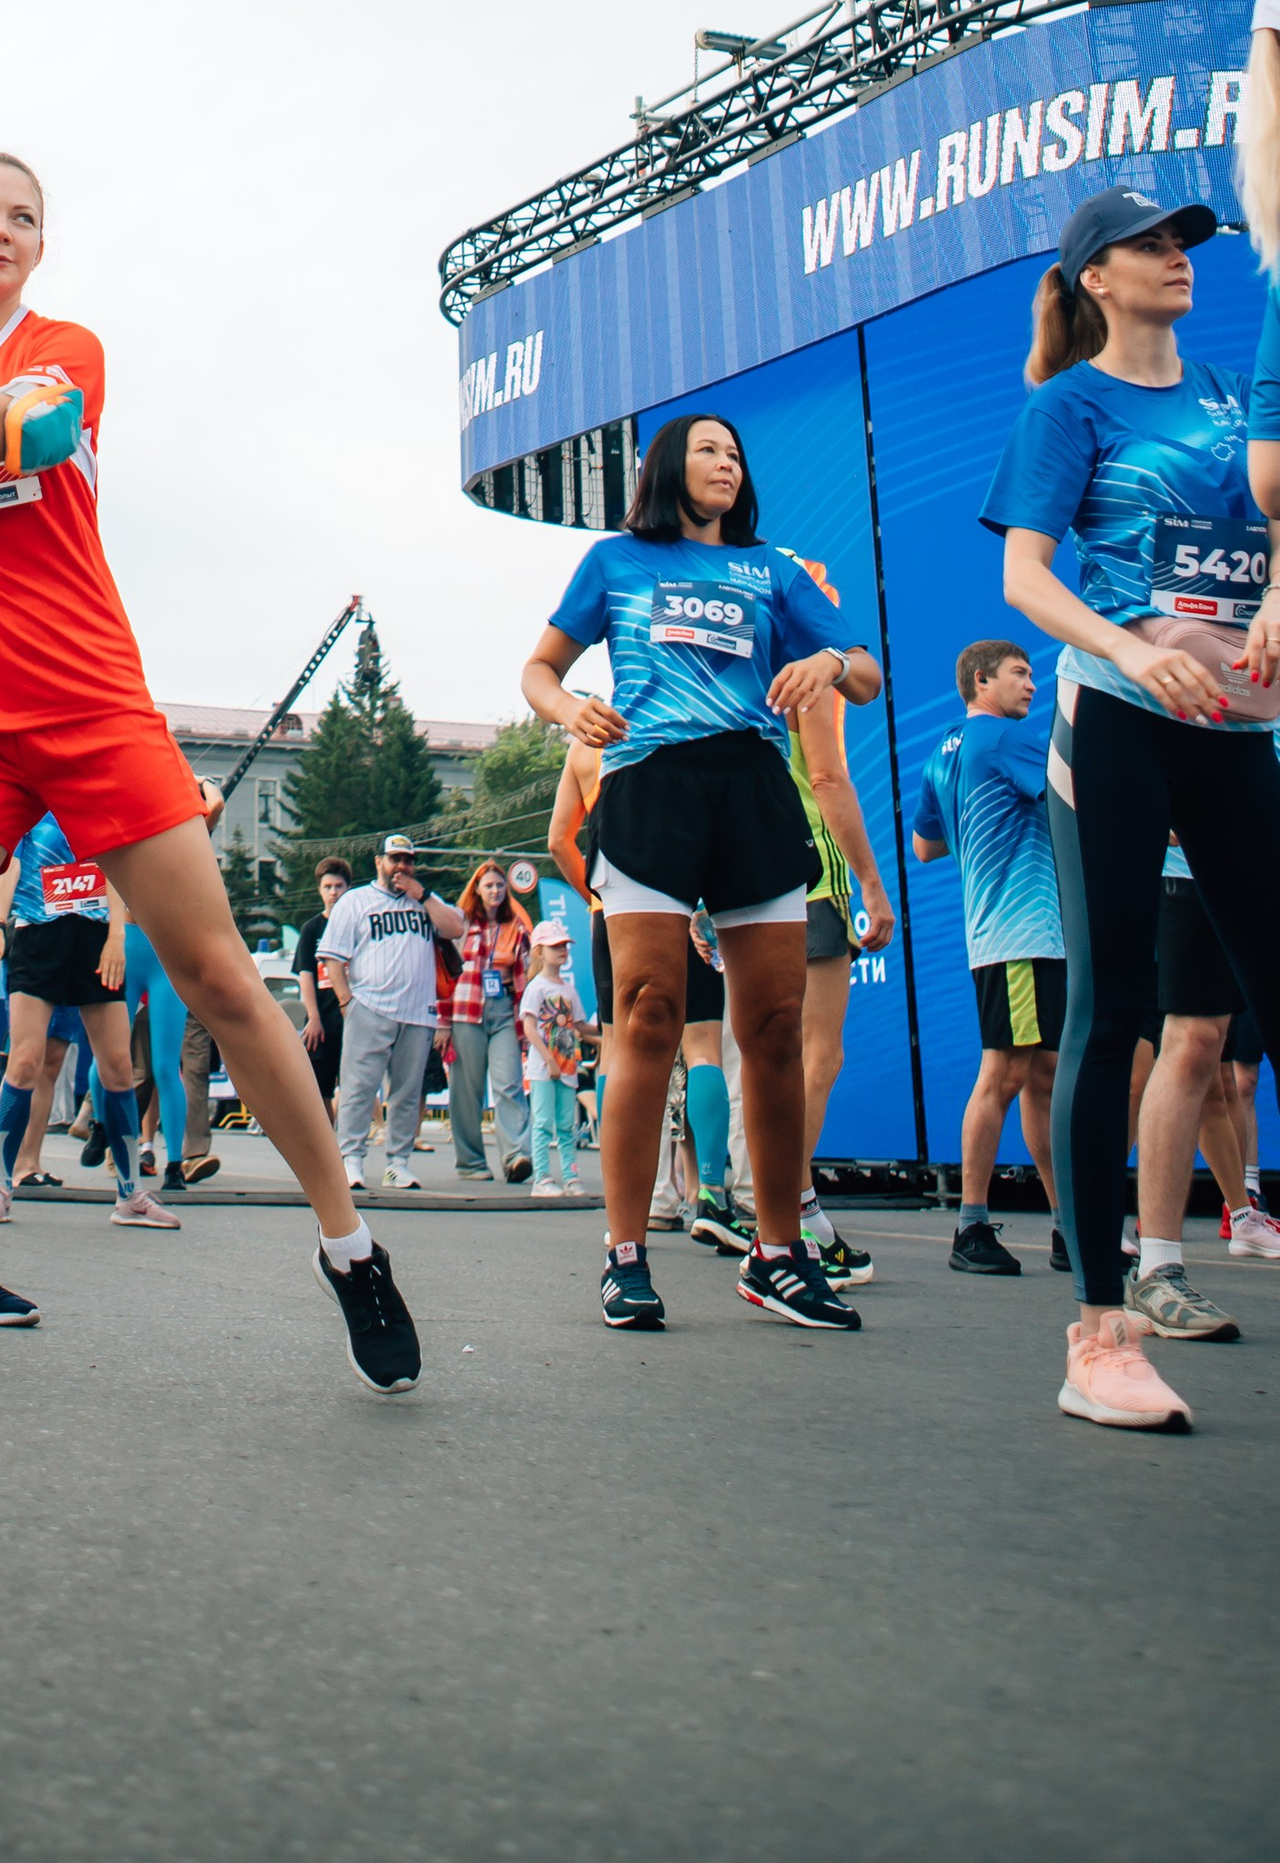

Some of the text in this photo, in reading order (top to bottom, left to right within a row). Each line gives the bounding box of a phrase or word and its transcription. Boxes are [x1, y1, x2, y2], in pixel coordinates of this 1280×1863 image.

[803, 71, 1249, 275] WWW.RUNSIM.R
[460, 330, 544, 431] SIM.RU
[1172, 544, 1267, 584] 5420
[663, 595, 743, 626] 3069
[52, 874, 96, 895] 2147
[516, 870, 532, 883] 40
[850, 957, 886, 985] ТИ
